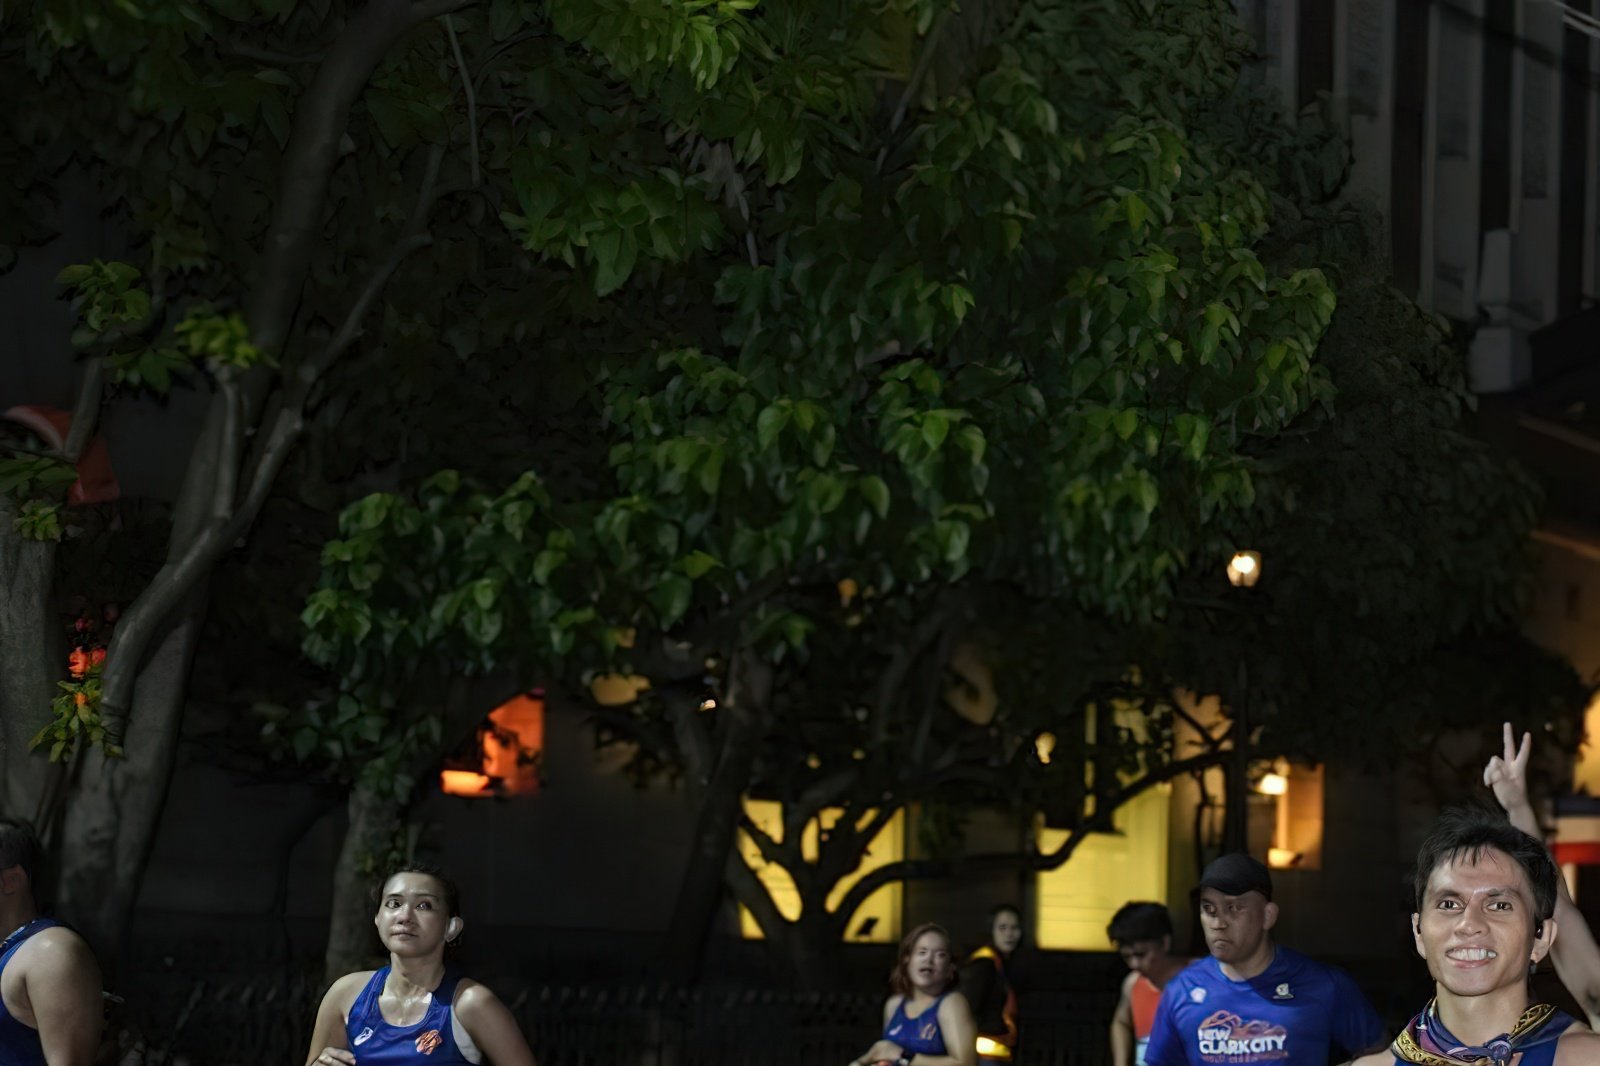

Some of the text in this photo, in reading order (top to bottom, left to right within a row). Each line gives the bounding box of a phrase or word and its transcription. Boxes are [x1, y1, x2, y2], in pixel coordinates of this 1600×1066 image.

[1198, 1025, 1232, 1041] NEW
[1199, 1034, 1287, 1055] CLARK CITY
